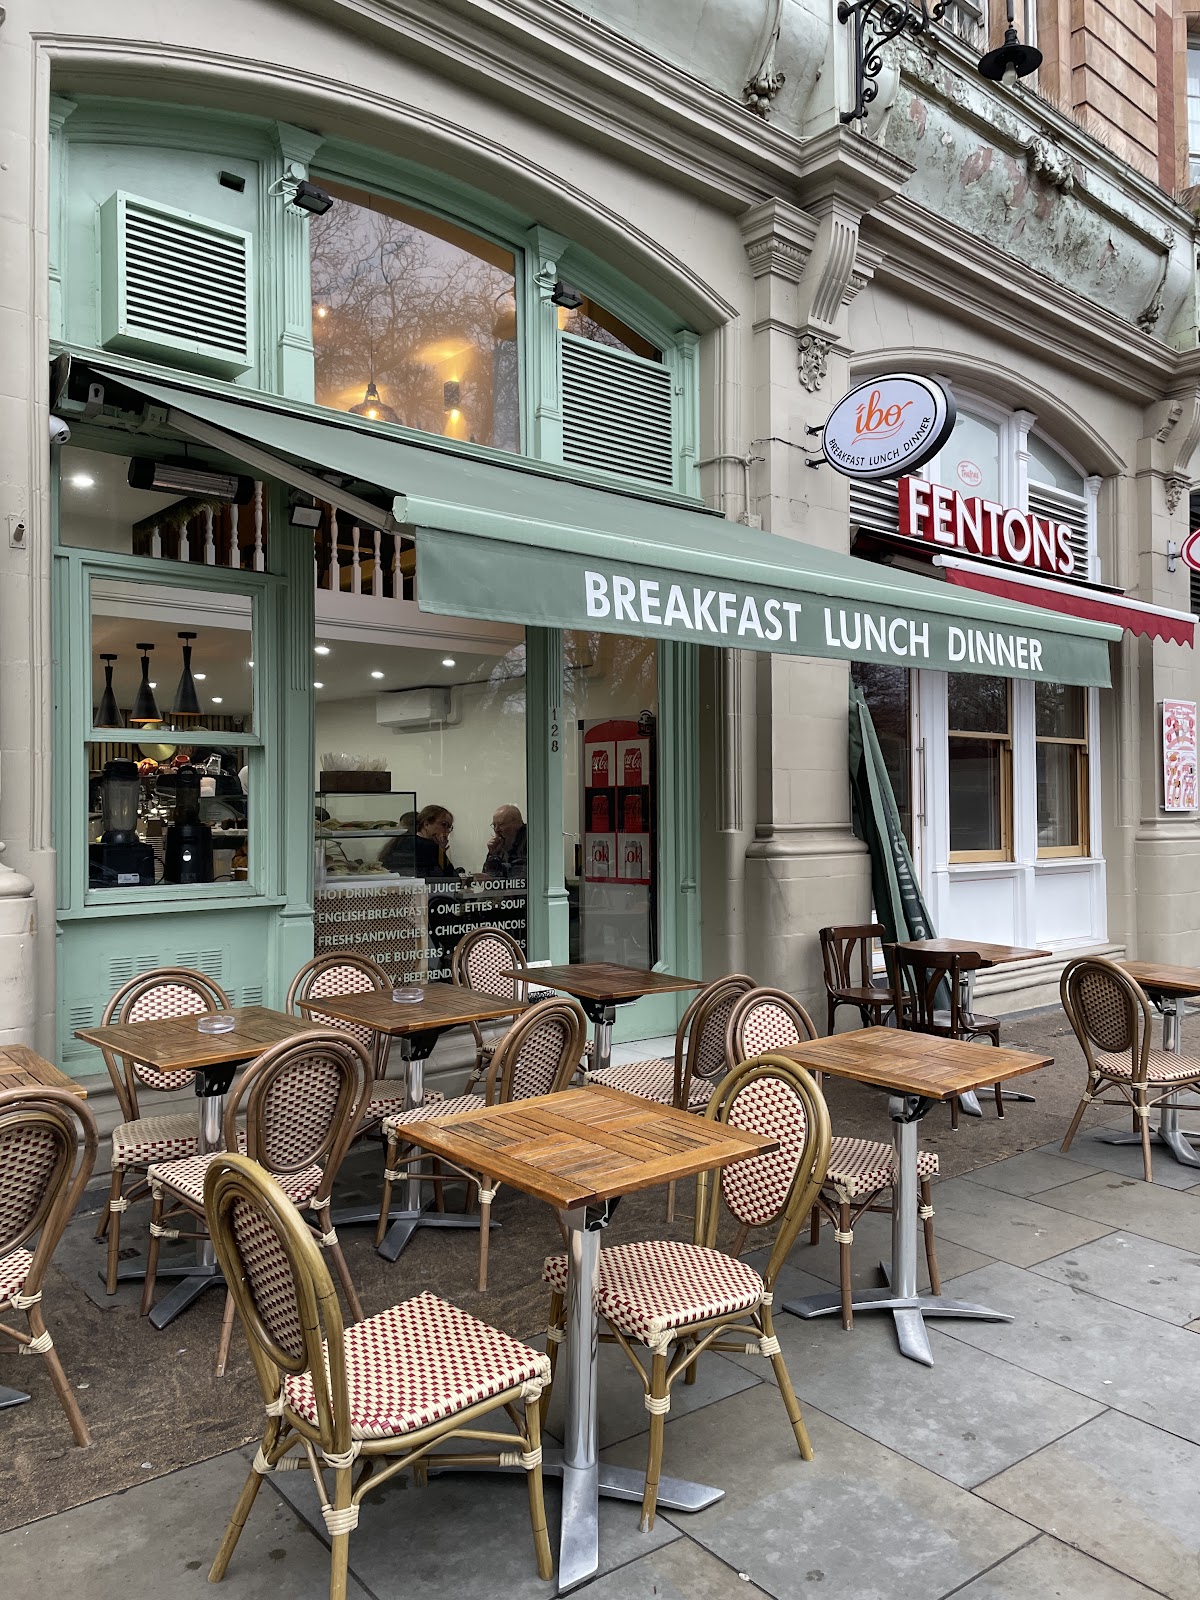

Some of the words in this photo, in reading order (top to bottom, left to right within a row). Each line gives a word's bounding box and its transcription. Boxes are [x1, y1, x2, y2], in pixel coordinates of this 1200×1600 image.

[828, 438, 865, 466] BREAKFAST
[869, 448, 900, 466] LUNCH
[903, 416, 931, 451] DINNER
[899, 475, 1075, 575] FENTONS
[585, 569, 802, 643] BREAKFAST
[823, 606, 930, 658] LUNCH
[948, 625, 1044, 673] DINNER
[318, 889, 345, 901] HOT
[346, 886, 388, 899] DRINKS
[399, 884, 431, 896] FRESH
[433, 881, 462, 893] JUICE
[470, 878, 526, 891] SMOOTHIES
[318, 911, 367, 924] ENGLISH
[368, 906, 428, 920] BREAKFAST
[501, 898, 526, 910] SOUP
[318, 934, 354, 947] FRESH
[355, 927, 426, 943] SANDWICHES
[435, 922, 478, 936] CHICKEN
[394, 947, 443, 962] BURGERS
[404, 971, 425, 983] BEEF
